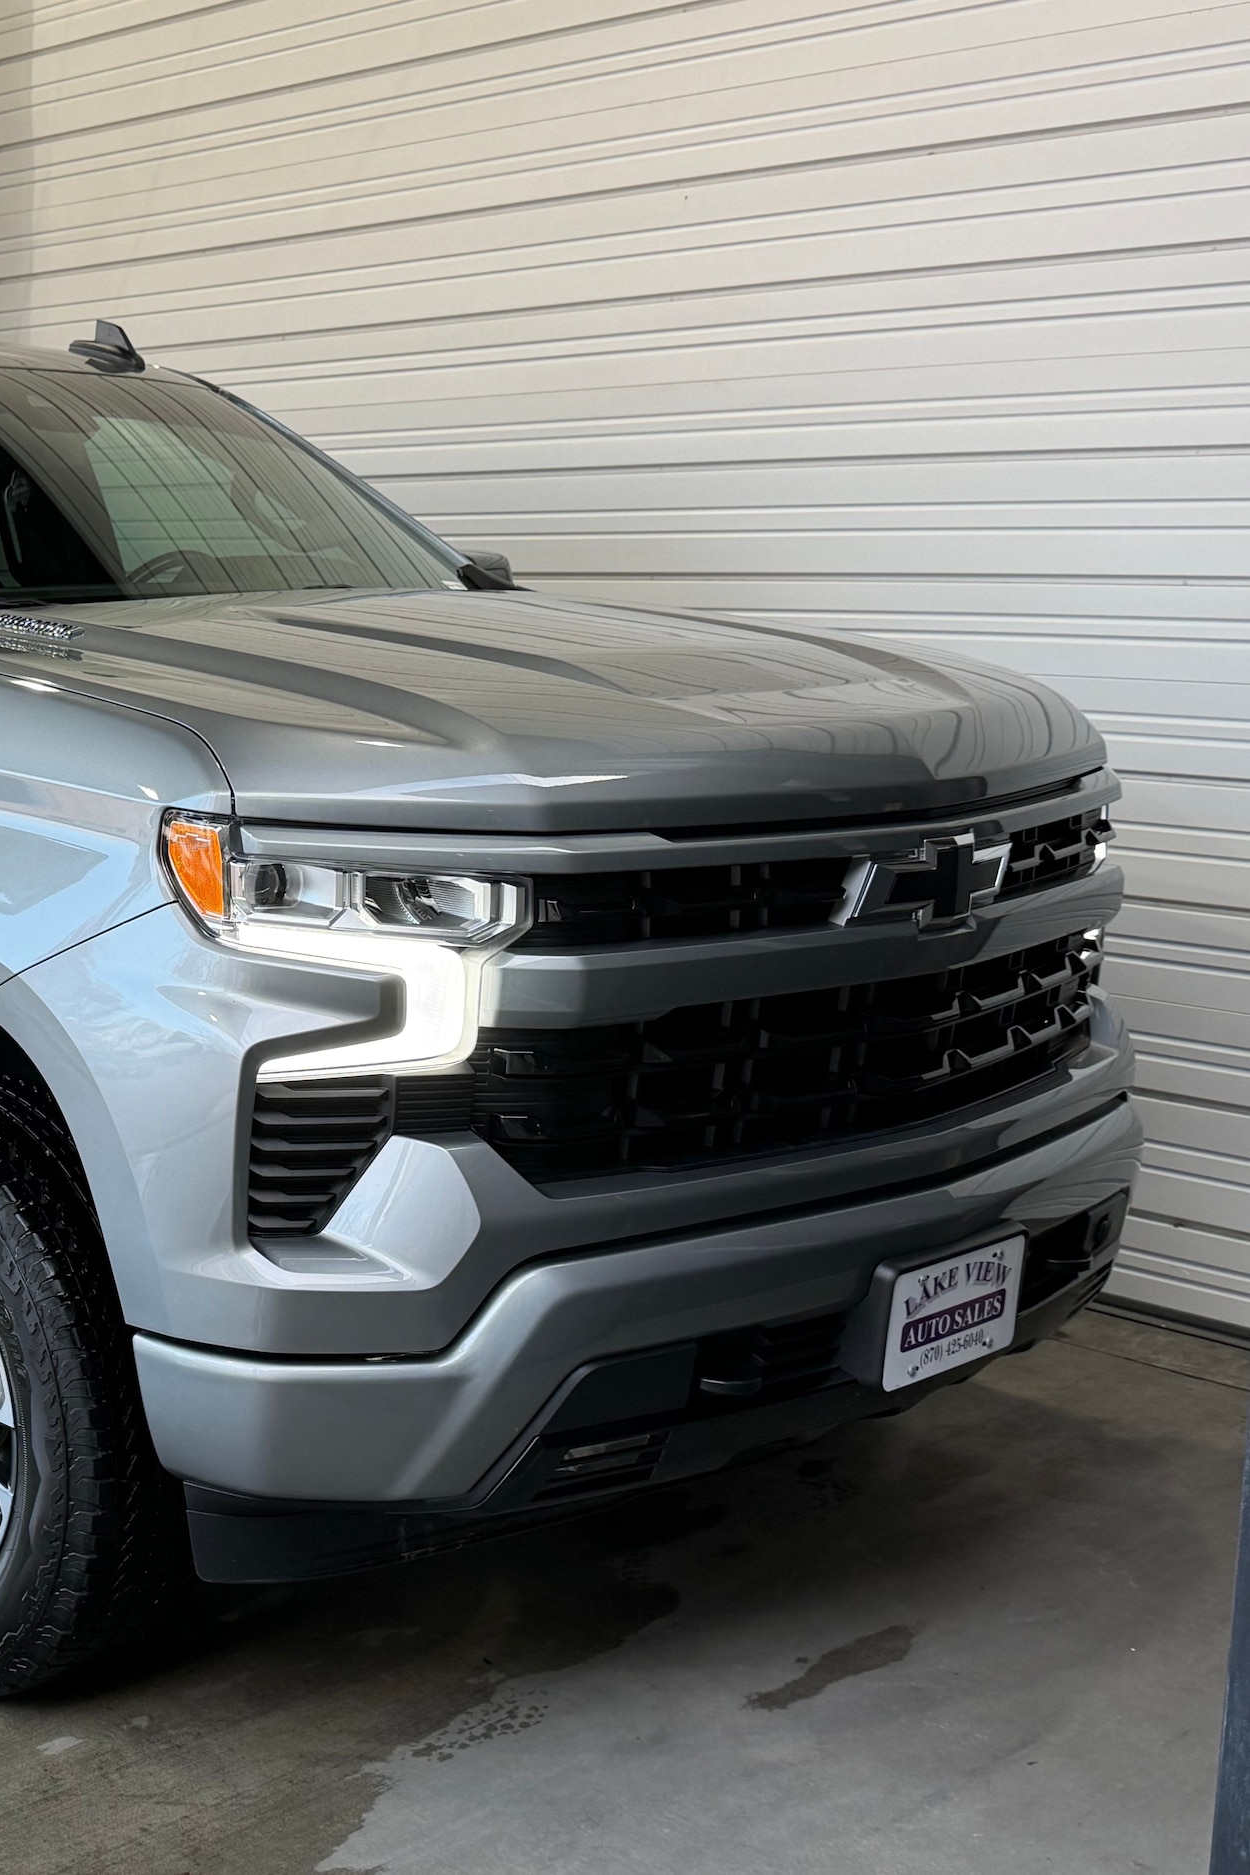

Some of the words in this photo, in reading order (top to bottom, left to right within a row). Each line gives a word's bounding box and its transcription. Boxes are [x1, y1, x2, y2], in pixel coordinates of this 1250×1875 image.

[903, 1266, 959, 1320] LAKE
[965, 1260, 1012, 1288] VIEW
[904, 1314, 950, 1348] AUTO
[953, 1295, 1002, 1330] SALES
[919, 1344, 943, 1368] (870)
